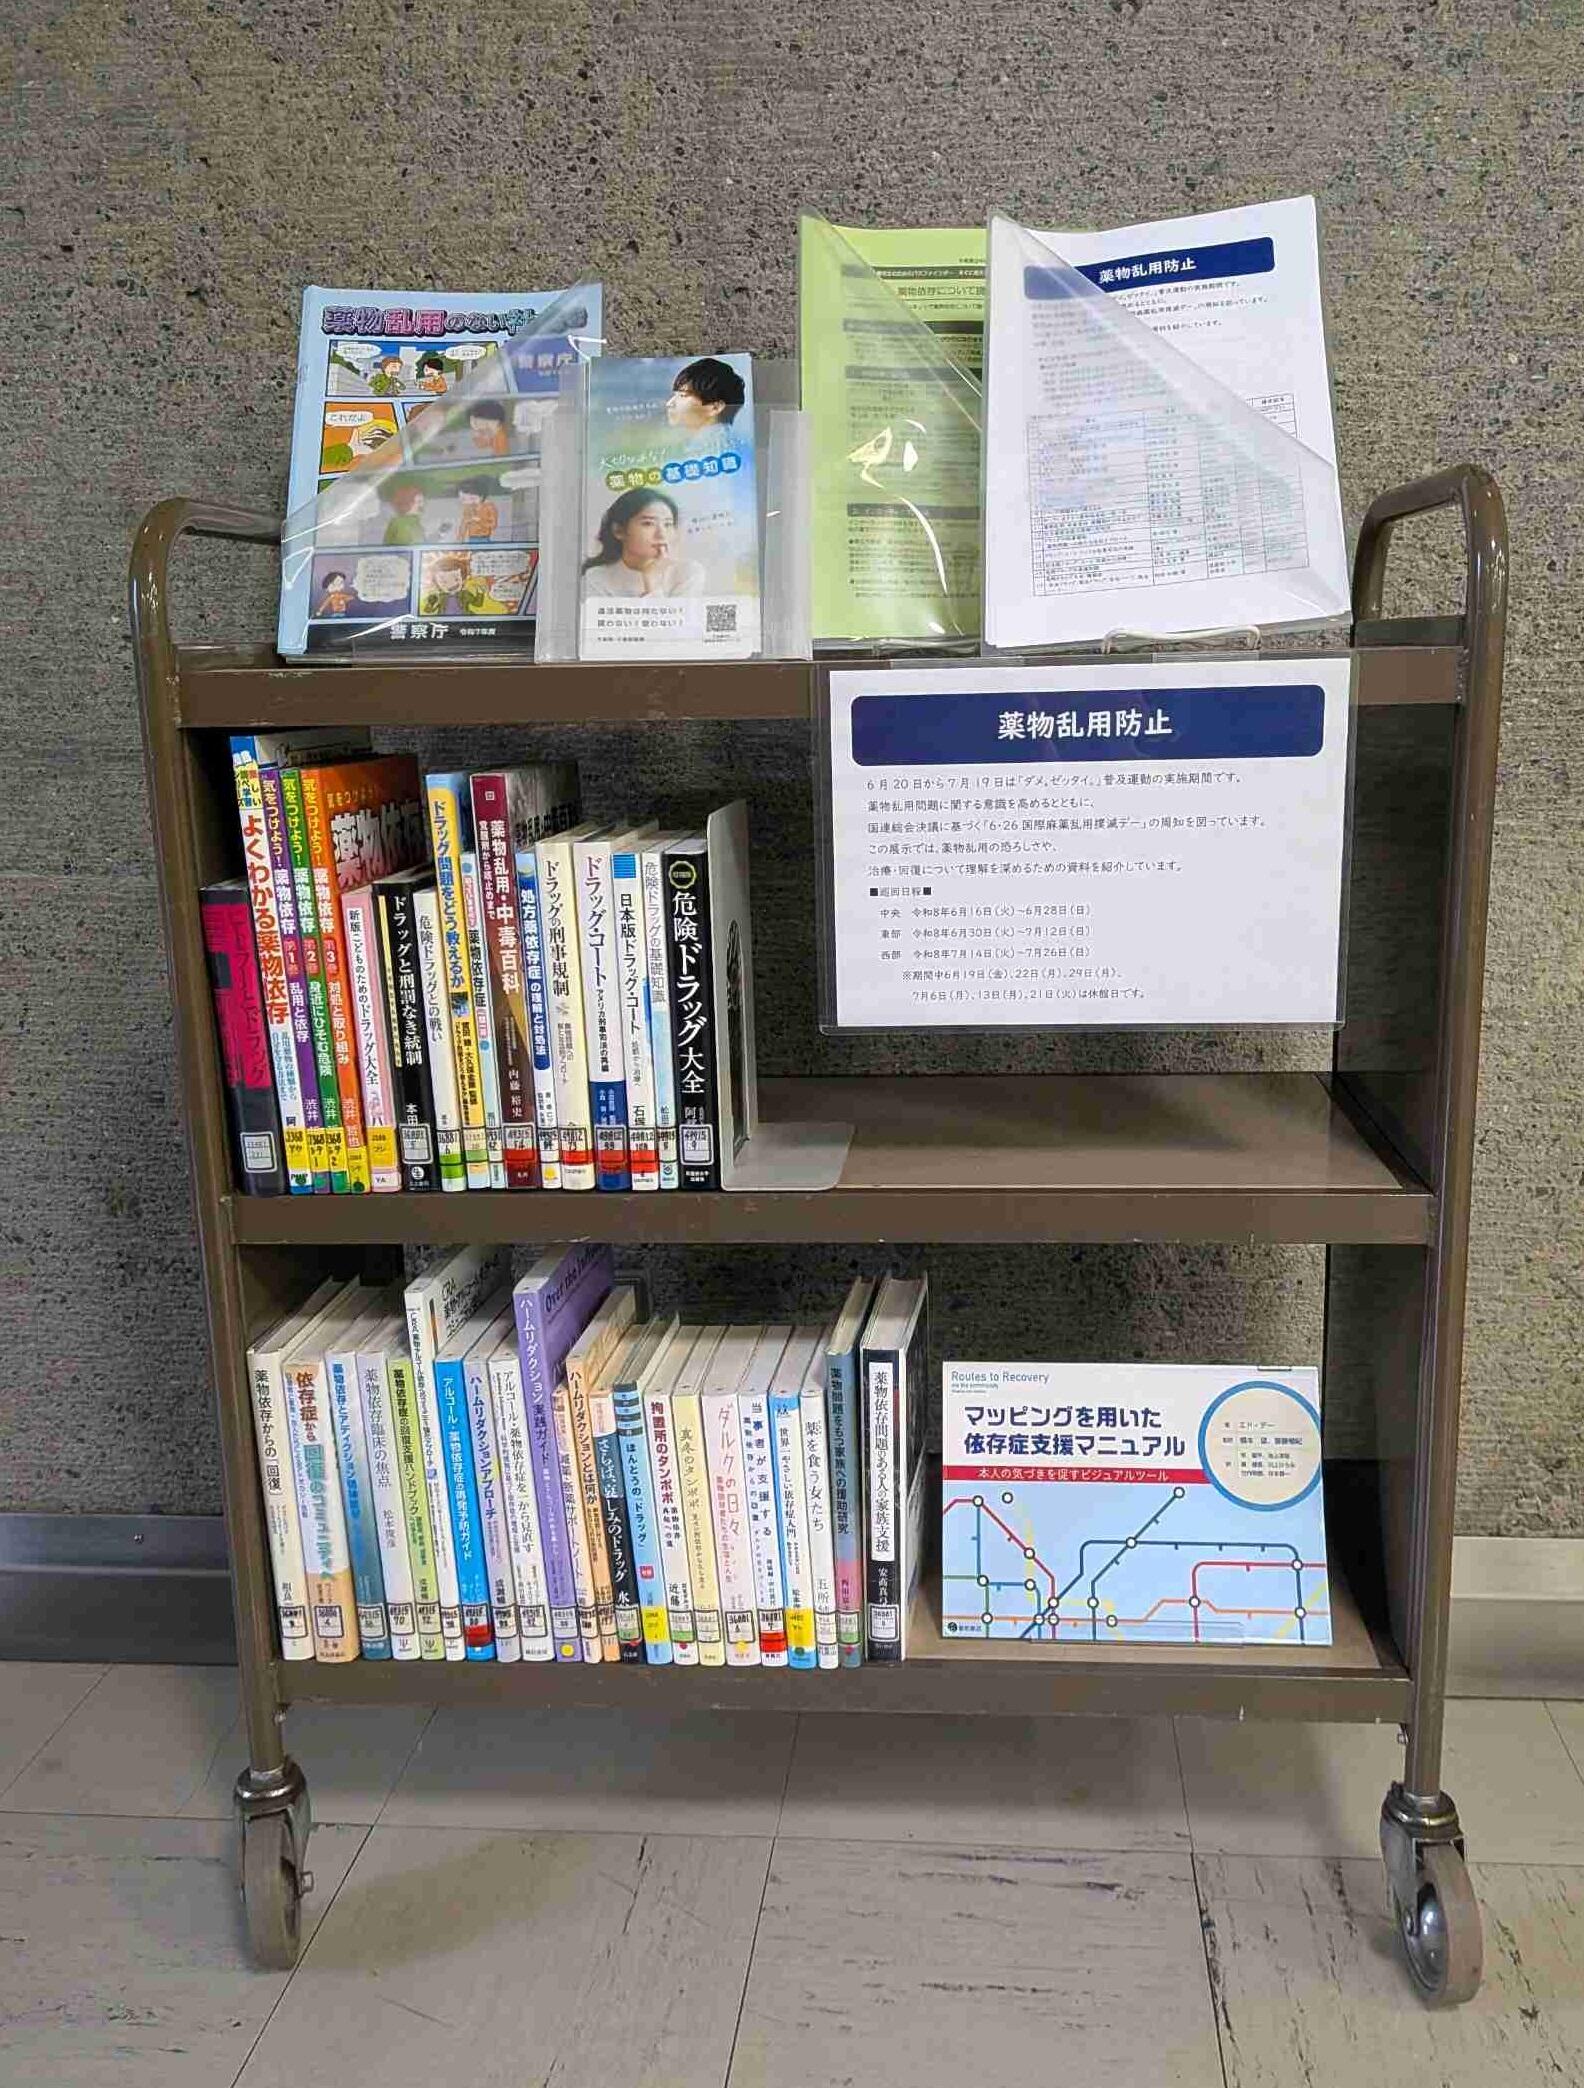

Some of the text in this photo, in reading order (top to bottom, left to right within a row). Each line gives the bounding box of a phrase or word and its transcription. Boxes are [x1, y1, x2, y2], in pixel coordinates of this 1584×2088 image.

[1099, 257, 1197, 285] 薬物乱用防止
[389, 623, 449, 640] 警察庁
[998, 709, 1173, 741] 薬物乱用防止
[867, 797, 1094, 812] 薬物乱用問題に関する意識を高めるとともに、
[869, 841, 1057, 855] この展示では、薬物乱用の恐ろしさや、
[243, 815, 290, 1024] よくわかる薬物依存
[273, 869, 296, 934] 薬物依存
[293, 867, 315, 933] 薬物依存
[313, 867, 335, 933] 薬物依存
[433, 800, 466, 988] ドラッグ問題をどう教えるか
[490, 820, 522, 994] 薬物乱用・中毒百科
[545, 859, 571, 997] ドラッグの刑事規制
[585, 856, 607, 988] ドラッグ・コート
[644, 861, 666, 1004] 危険ドラッグの基礎知識
[880, 908, 901, 918] 中央
[880, 929, 902, 939] 東部
[392, 895, 424, 1066] ドラッグと刑罰なき統制
[420, 915, 444, 1042] 危険ドラッグとの戦い
[468, 929, 488, 1007] 薬物依存症
[619, 893, 641, 1036] 日本版ドラッグ・コート
[671, 892, 708, 1094] 危険ドラッグ大全
[880, 950, 902, 960] 西部
[289, 982, 310, 1043] 乱用と依存
[309, 981, 333, 1077] 身近にひそむ危険
[296, 1372, 317, 1442] 依存症から
[365, 1368, 393, 1488] 薬物依存臨床の焦点
[520, 1299, 551, 1468] ハームリダクション実践ガイド
[951, 1371, 1050, 1385] Routes to Recovery
[964, 1405, 1162, 1429] マッピングを用いた
[469, 1376, 496, 1521] ハームリダクションアプローチ
[570, 1371, 599, 1505] ハームリダクションとは何か
[650, 1401, 675, 1505] 拘置所のタンポポ
[679, 1428, 700, 1510] 真冬のタンポポ
[717, 1402, 742, 1536] ダルクの日々
[751, 1402, 772, 1537] 当事者が支援する
[779, 1427, 797, 1539] 世界一やさしい依存症入門
[804, 1420, 826, 1532] 薬を食う女たち
[829, 1367, 850, 1535] 薬物問題をもつ家族への援助研究
[873, 1370, 891, 1553] 薬物依存問題のある人の家族支援
[964, 1431, 1186, 1457] 依存症支援マニュアル
[978, 1468, 1169, 1482] 本人の気づきを促すビジュアルツール
